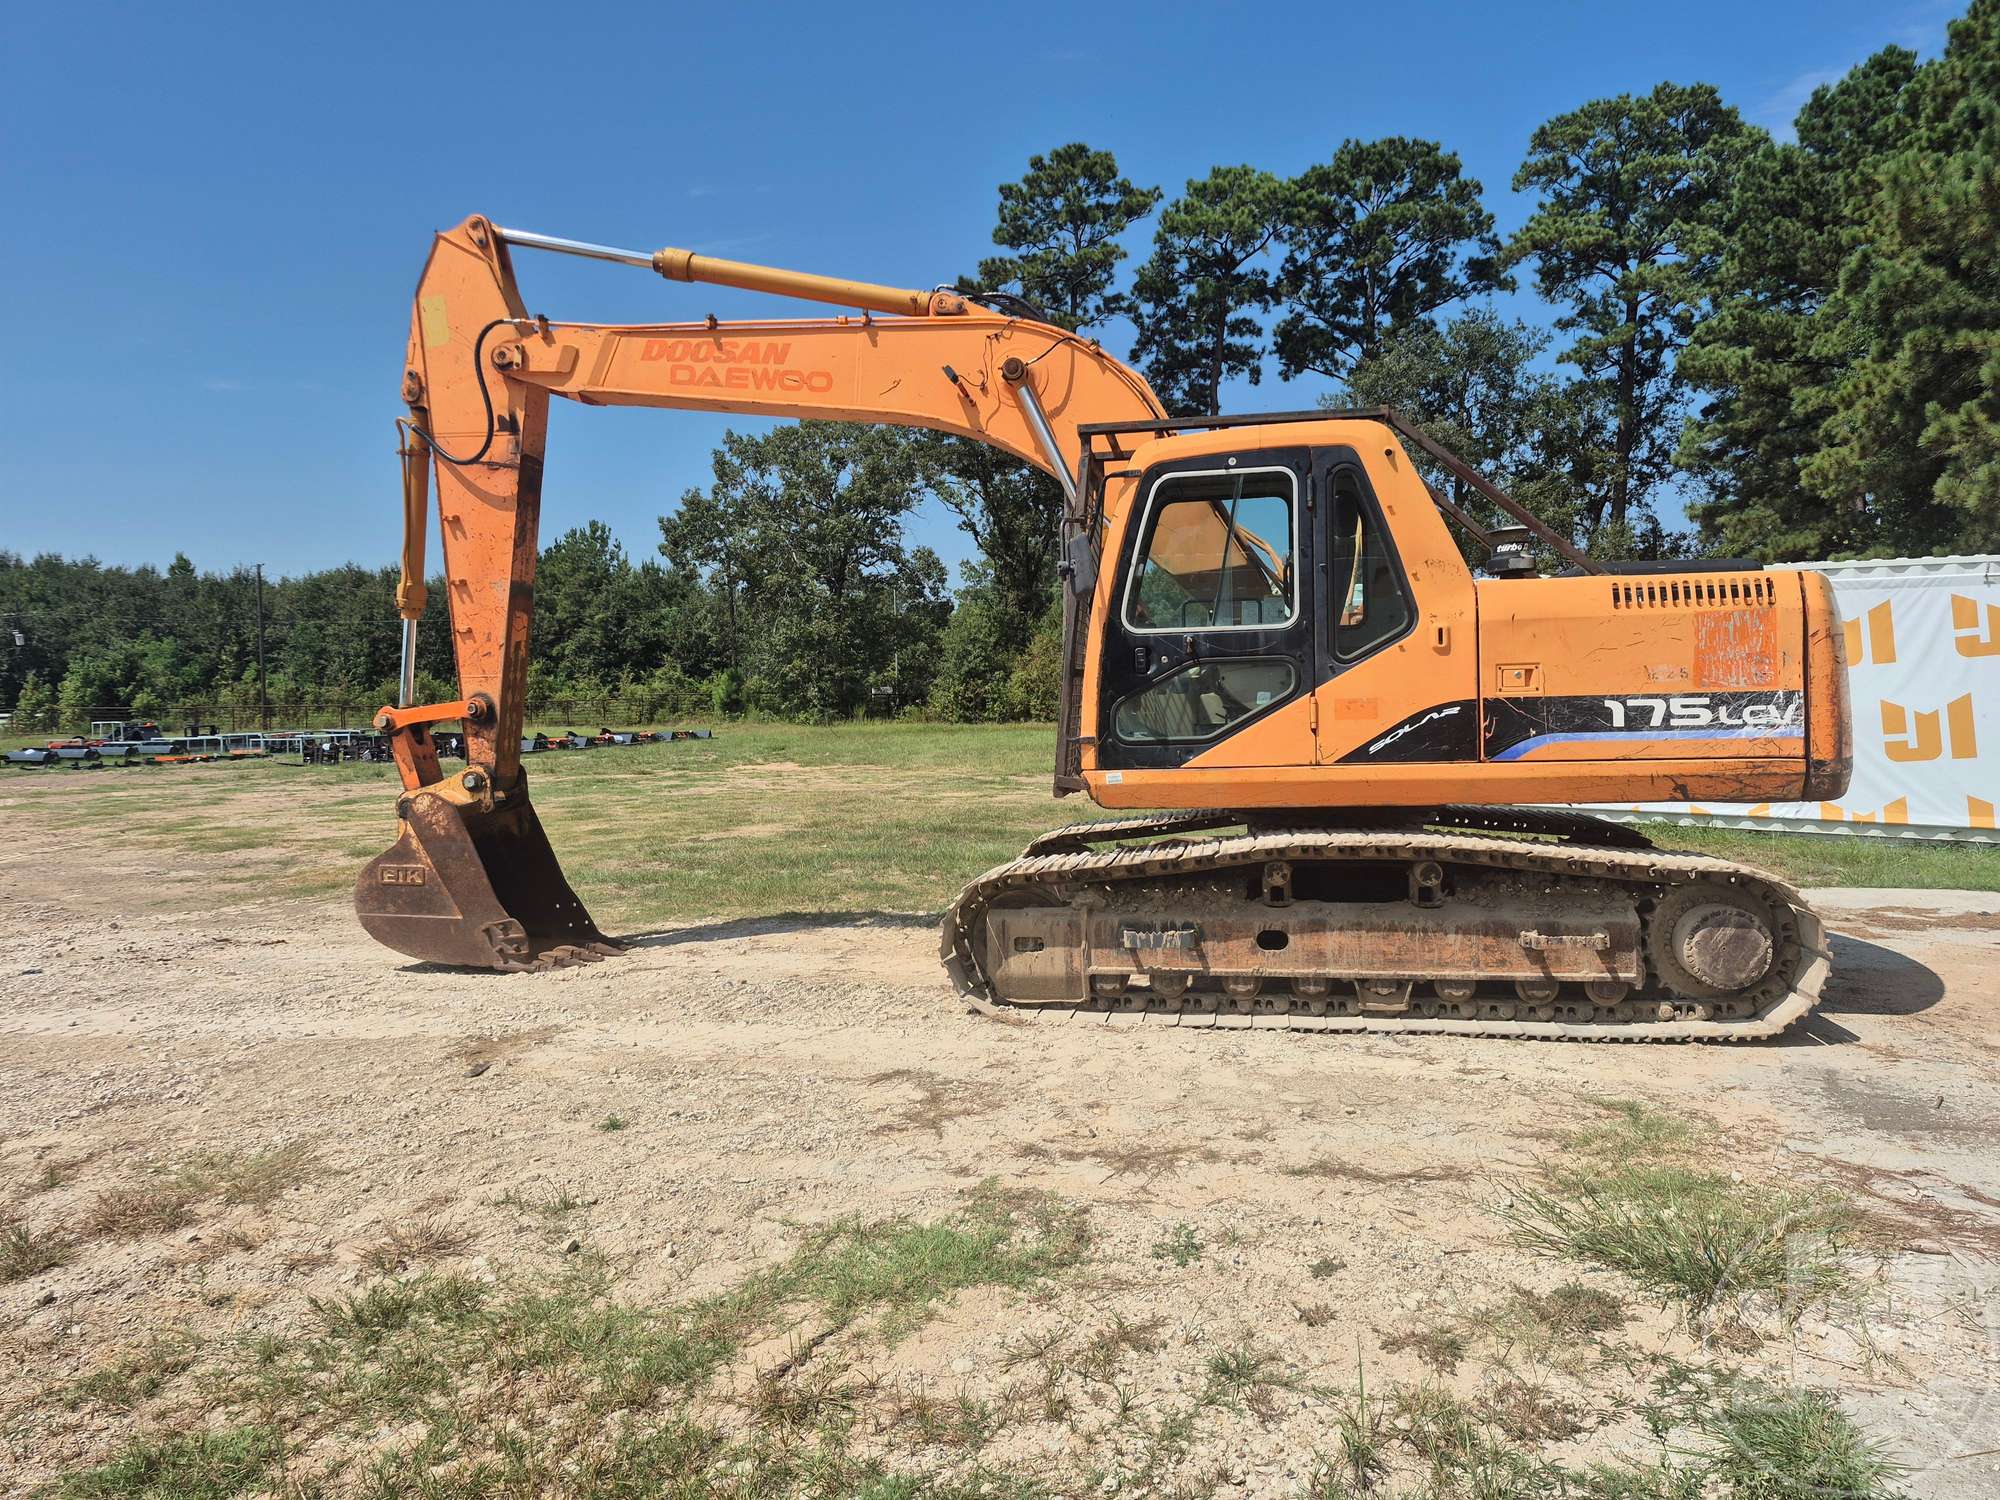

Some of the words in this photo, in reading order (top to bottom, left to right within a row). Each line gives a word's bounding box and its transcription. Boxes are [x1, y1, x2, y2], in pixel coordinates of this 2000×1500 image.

[641, 339, 792, 365] DOOSAN
[670, 364, 833, 392] DAEWOO
[1368, 706, 1461, 755] SOLAR
